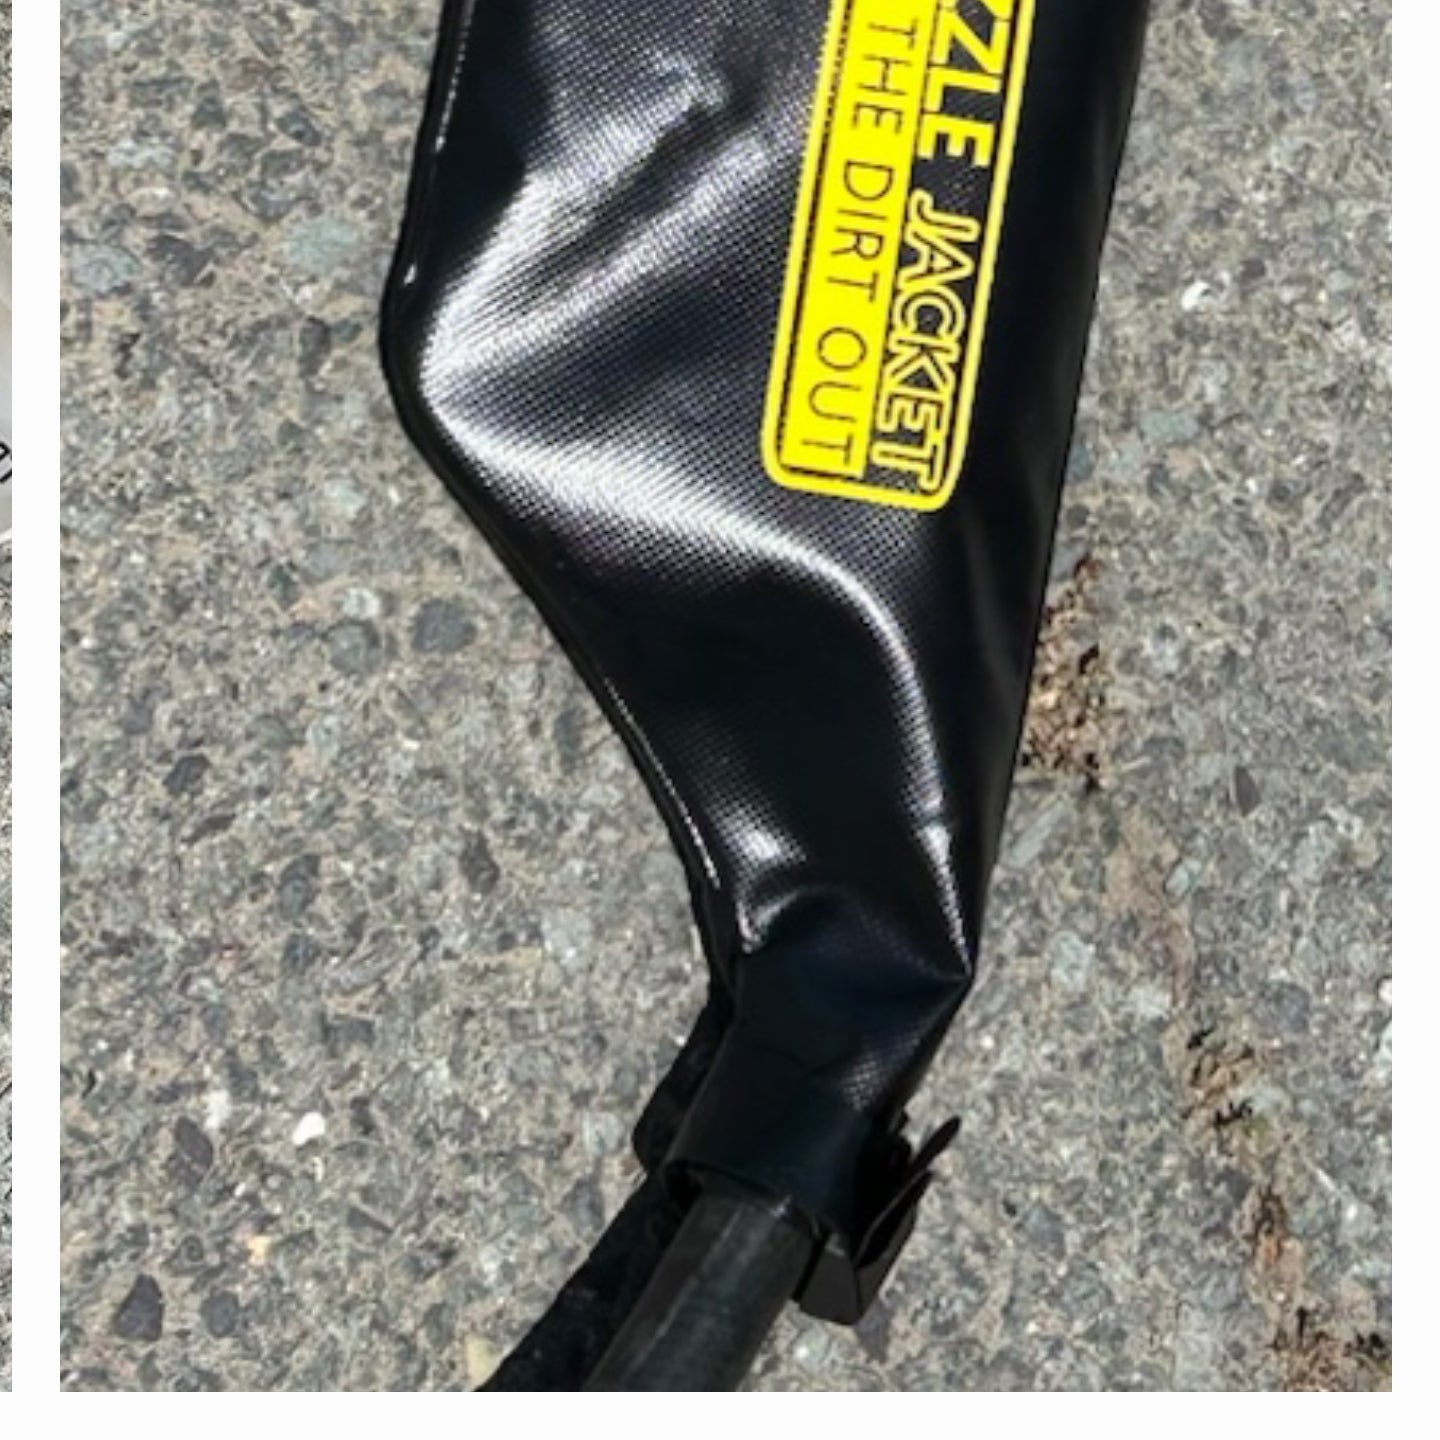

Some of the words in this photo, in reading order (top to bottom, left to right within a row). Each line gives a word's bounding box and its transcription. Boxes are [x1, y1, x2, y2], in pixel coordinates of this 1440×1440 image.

[849, 17, 918, 136] THE
[824, 160, 896, 303] DIRT
[801, 326, 869, 468] OUT
[871, 188, 982, 490] JACKET
